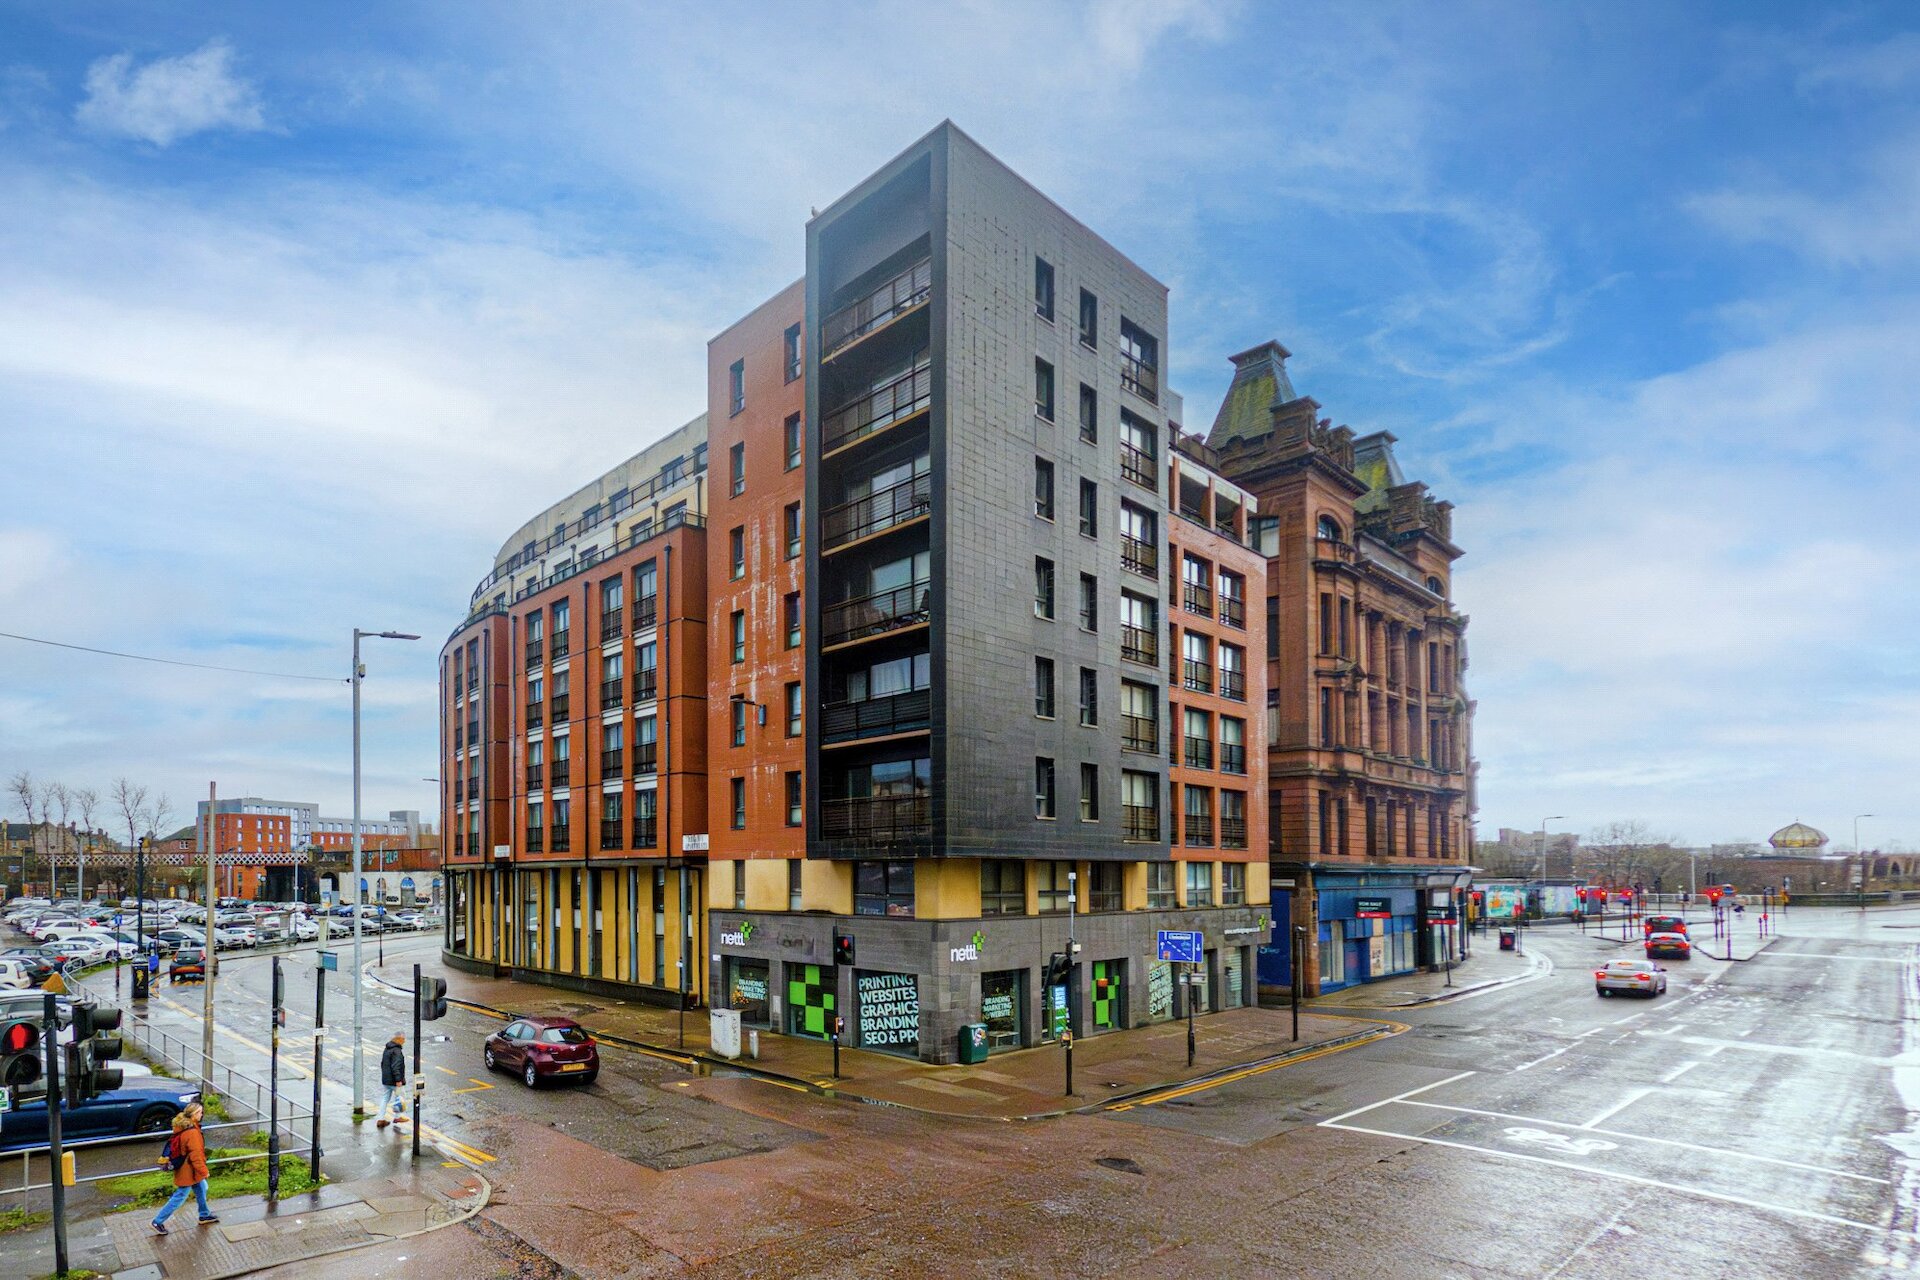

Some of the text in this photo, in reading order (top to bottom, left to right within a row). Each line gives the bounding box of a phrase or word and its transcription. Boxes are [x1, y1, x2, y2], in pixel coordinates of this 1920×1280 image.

[951, 944, 978, 961] nettl
[859, 975, 914, 991] PRINTING
[859, 987, 917, 1004] WEBSITES
[984, 995, 1010, 1006] BRANDING
[861, 1001, 919, 1017] GRAPHICS
[865, 1031, 887, 1044] SEO
[889, 1030, 899, 1043] &
